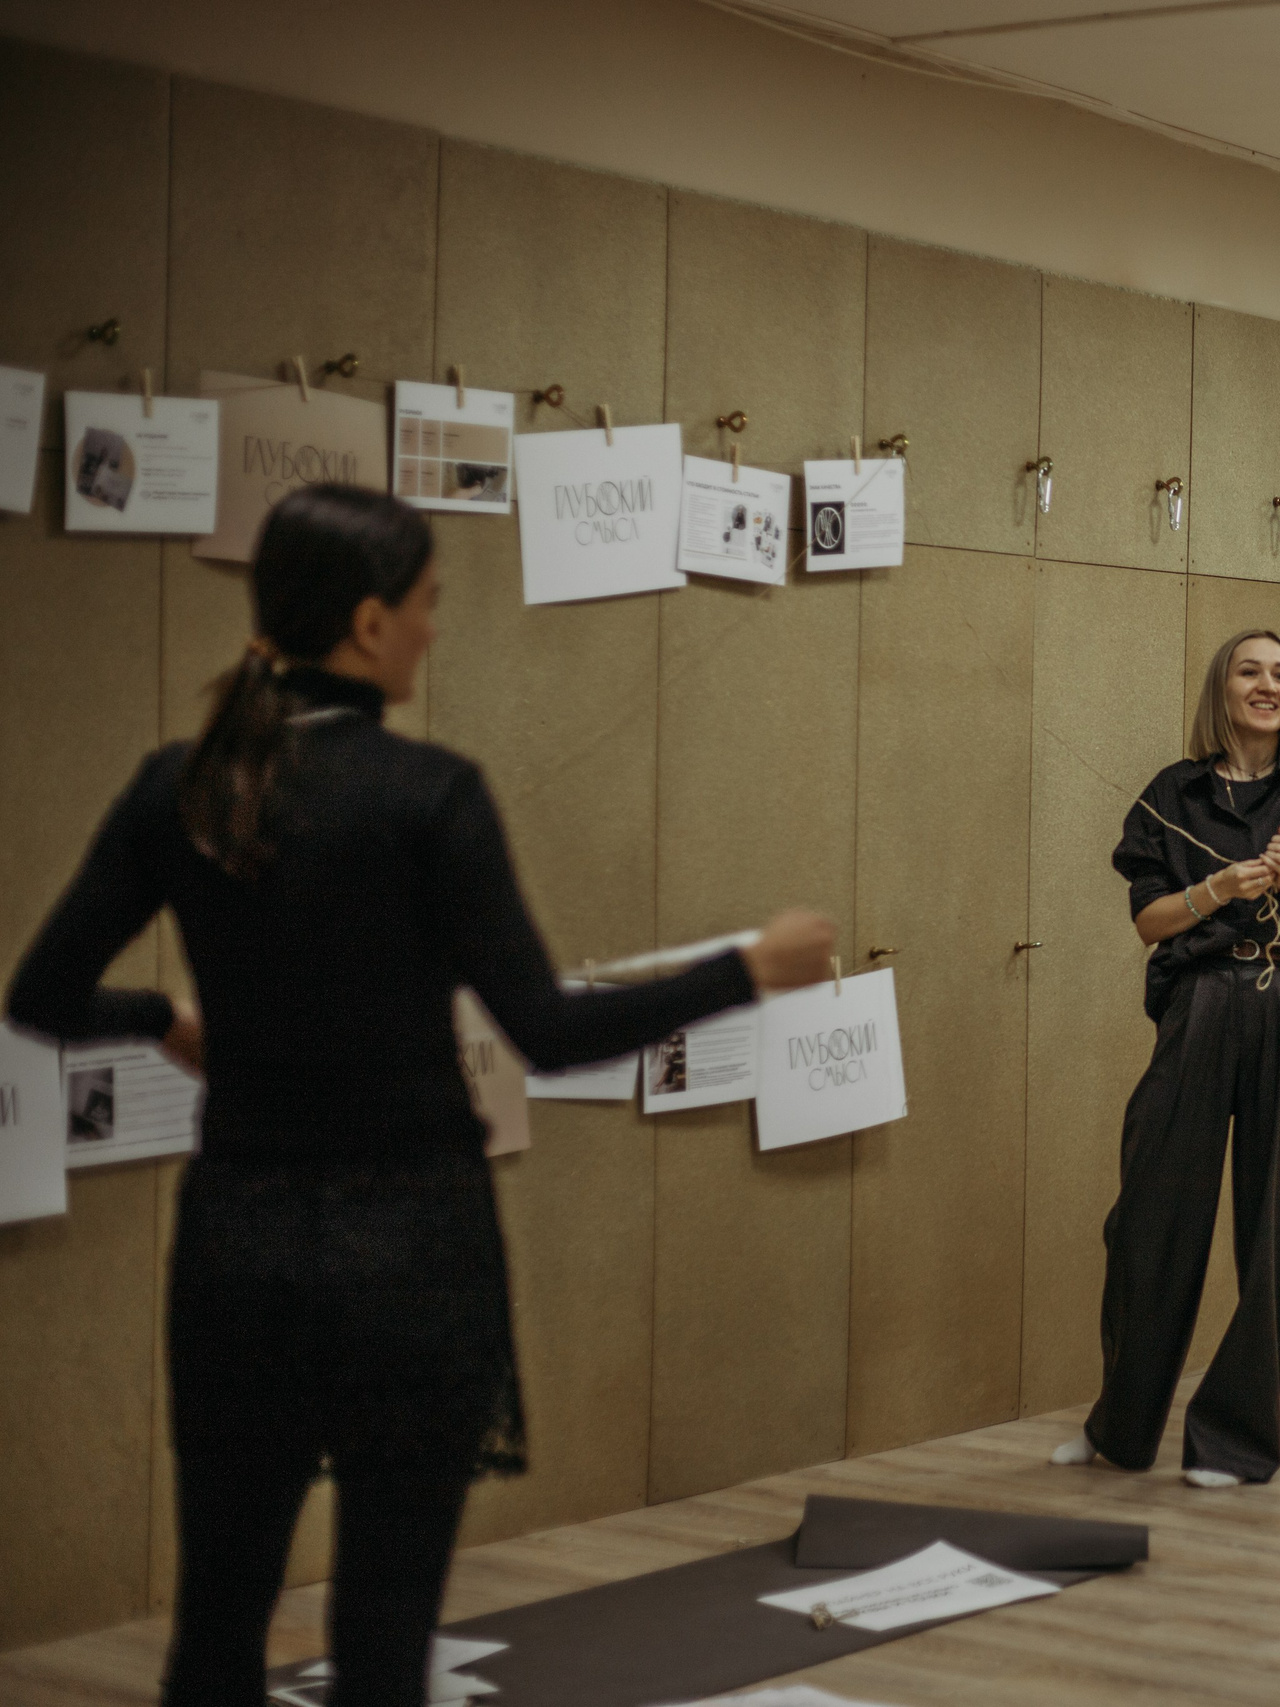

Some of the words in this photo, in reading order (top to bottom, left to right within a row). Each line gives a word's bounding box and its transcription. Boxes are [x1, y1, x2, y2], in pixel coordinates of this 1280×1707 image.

[243, 435, 359, 485] ГЛУБОКИЙ
[554, 474, 654, 520] ГЛУБОКИЙ
[574, 517, 640, 546] СМЫСЛ
[788, 1018, 878, 1070] ГЛУБОКИЙ
[808, 1059, 868, 1092] СМЫСЛ
